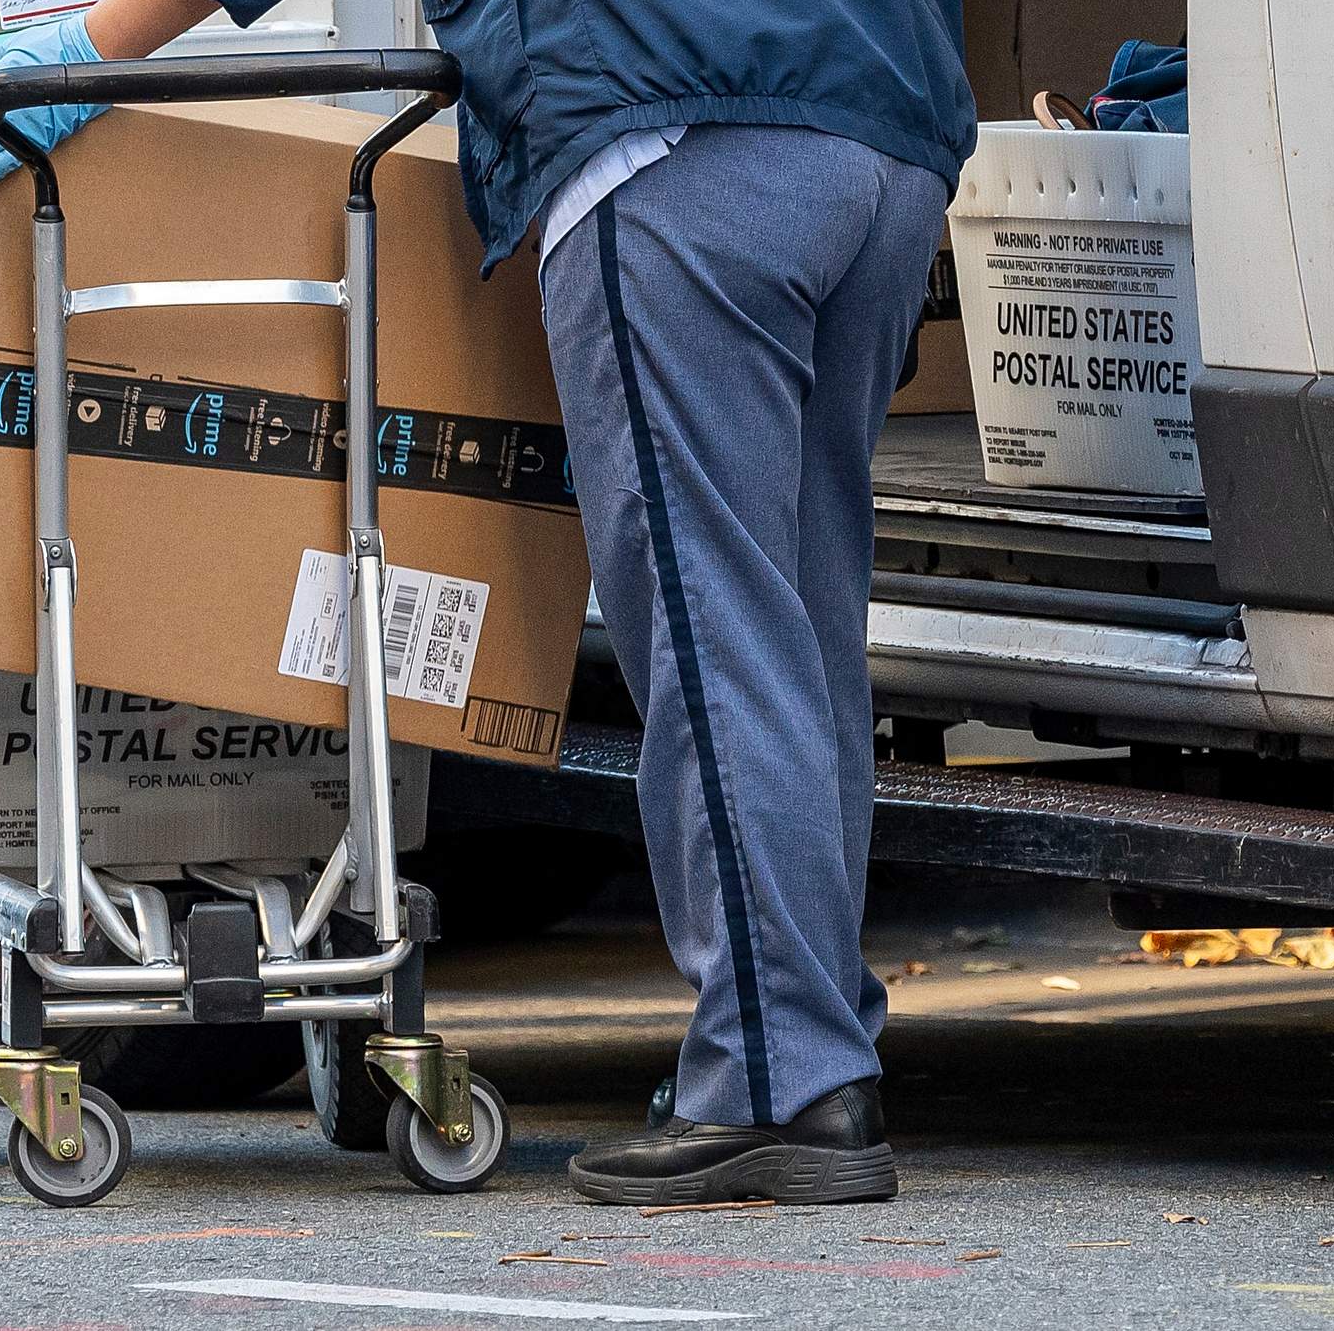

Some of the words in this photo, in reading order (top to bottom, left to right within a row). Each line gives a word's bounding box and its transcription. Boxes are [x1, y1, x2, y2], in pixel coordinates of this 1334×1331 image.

[994, 231, 1041, 249] WARNING
[1050, 235, 1070, 251] NOT
[1073, 236, 1094, 253] FOR
[1097, 237, 1139, 256] PRIVATE
[1143, 239, 1164, 256] USE
[987, 259, 1015, 270] MAXIMUM
[1016, 260, 1041, 271] PENALTY
[1042, 261, 1054, 272] FOR
[1055, 262, 1073, 273] THEFT
[1074, 263, 1083, 274] OR
[1083, 264, 1107, 276] MISUSE
[1108, 265, 1116, 276] OF
[1116, 266, 1140, 278] POSTAL
[1141, 267, 1175, 279] PROPERTY
[1003, 273, 1020, 285] $1,000
[1021, 275, 1034, 286] FINE
[1034, 276, 1047, 287] AND
[1048, 277, 1052, 287] 3
[1052, 277, 1072, 288] YEARS
[1073, 278, 1117, 291] IMPRISONMENT
[1118, 280, 1127, 293] (18
[1128, 281, 1142, 292] USC
[997, 302, 1077, 339] UNITED
[1084, 307, 1174, 345] STATES
[992, 351, 1080, 390] POSTAL
[1086, 356, 1187, 395] SERVICE
[13, 371, 35, 436] prime
[255, 398, 269, 419] free
[319, 402, 331, 427] video
[1057, 400, 1076, 415] FOR
[1077, 402, 1097, 417] MAIL
[1099, 403, 1123, 418] ONLY
[124, 406, 139, 447] delivery
[202, 393, 225, 457] prime
[444, 421, 456, 442] free
[509, 426, 521, 447] free
[984, 425, 1002, 433] RETURN
[1008, 427, 1028, 436] NEAREST
[1029, 429, 1040, 437] POST
[249, 420, 265, 462] lstening
[392, 414, 414, 476] prime
[993, 438, 1010, 446] REPORT
[502, 448, 518, 489] listening
[3, 729, 177, 765] PSTAL
[191, 724, 350, 760] SERVIC
[128, 774, 162, 788] FOR
[167, 773, 205, 787] MAIL
[210, 772, 254, 786] ONLY
[11, 809, 23, 817] TO
[90, 806, 121, 814] OFFICE
